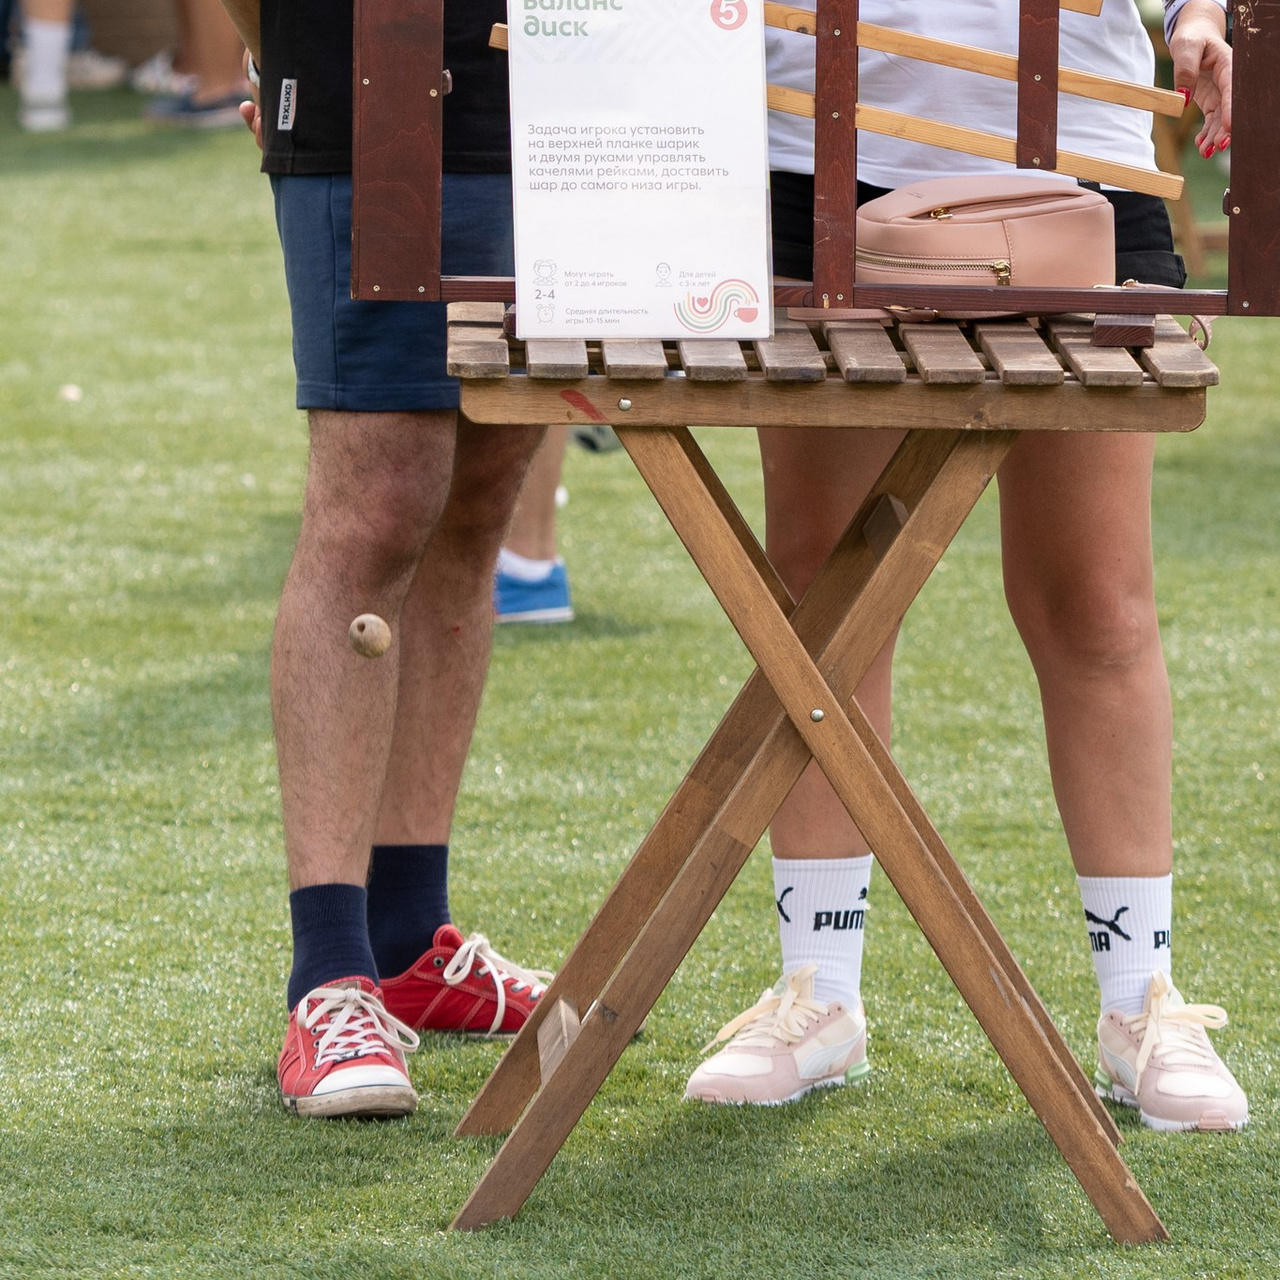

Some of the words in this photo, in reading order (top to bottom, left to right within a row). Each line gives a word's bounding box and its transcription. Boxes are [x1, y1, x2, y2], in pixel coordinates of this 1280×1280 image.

[523, 14, 589, 37] диск
[281, 83, 292, 126] TRXLHXD
[527, 123, 577, 136] Задача
[580, 125, 627, 137] игрока
[630, 125, 705, 137] установить
[528, 140, 545, 149] на
[548, 137, 603, 151] верхней
[606, 140, 653, 149] планке
[656, 140, 700, 151] шарик
[528, 154, 536, 162] и
[539, 154, 581, 165] двумя
[584, 154, 634, 165] руками
[637, 154, 706, 165] управлять
[529, 167, 594, 176] качелями
[597, 165, 658, 178] рейками,
[661, 167, 729, 178] доставить
[529, 181, 558, 192] шар
[560, 181, 578, 191] до
[580, 181, 628, 190] самого
[631, 181, 662, 190] низа
[666, 181, 702, 192] игры.
[564, 271, 587, 279] Могут
[534, 289, 555, 300] 2-4
